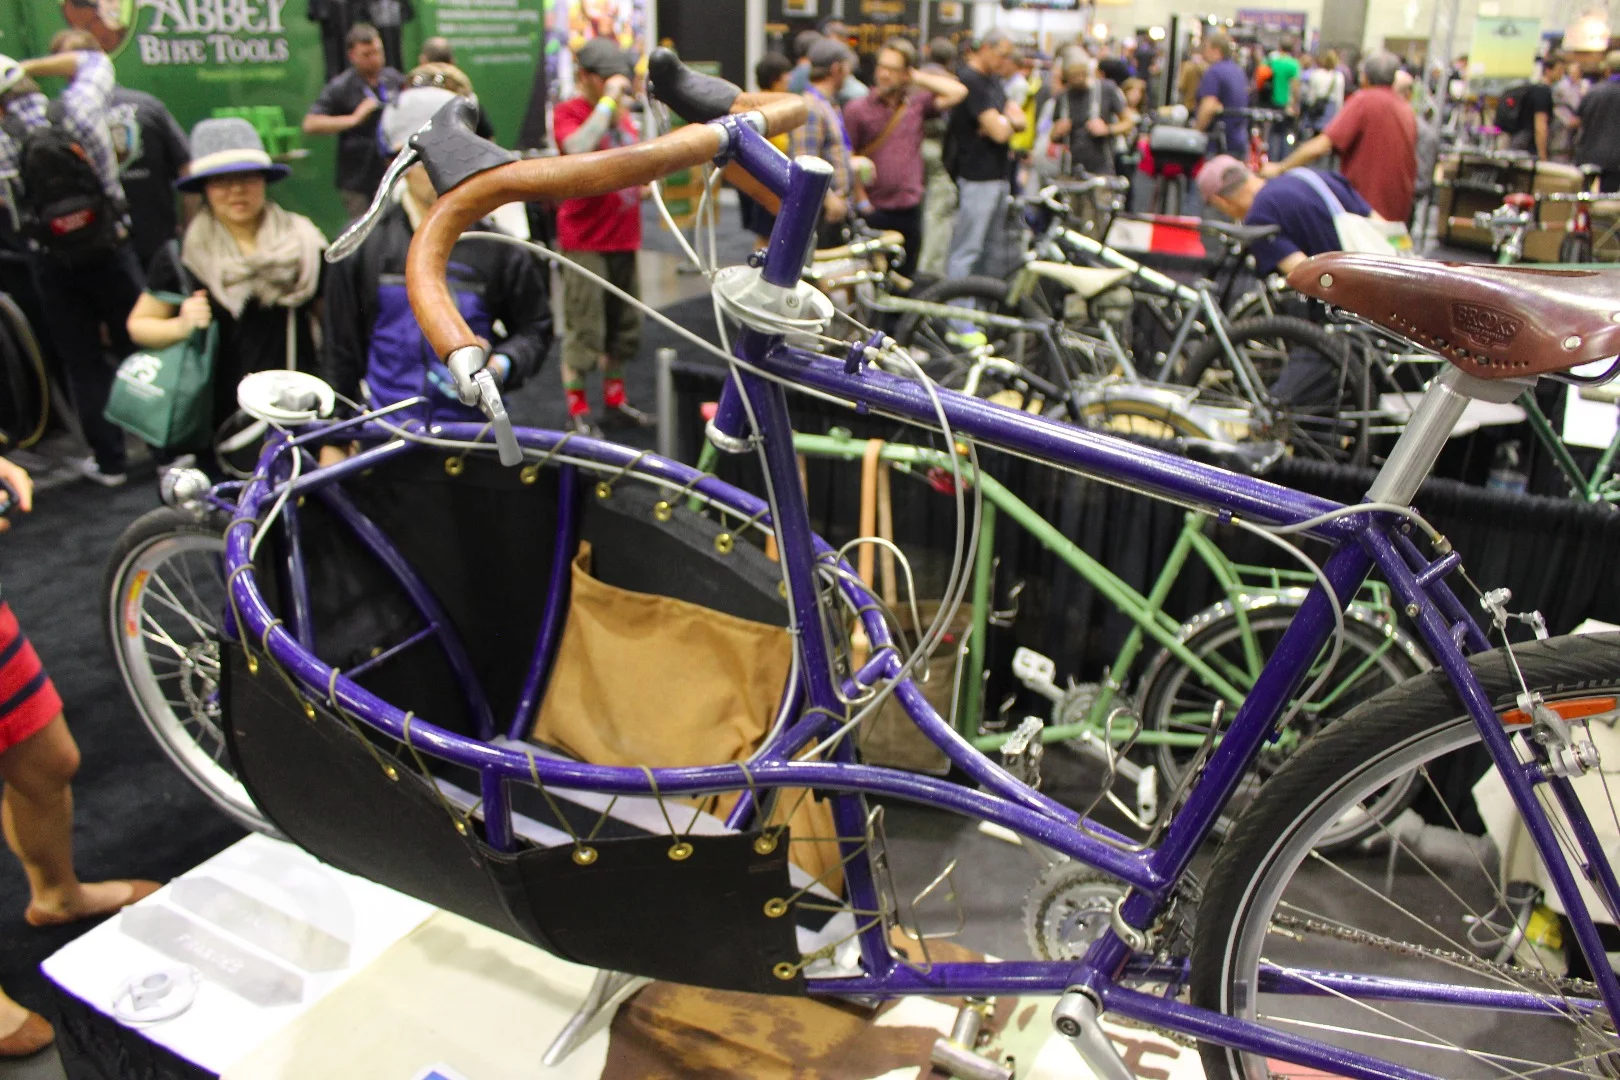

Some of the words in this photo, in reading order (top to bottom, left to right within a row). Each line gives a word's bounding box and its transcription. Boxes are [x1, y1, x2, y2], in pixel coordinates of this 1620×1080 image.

[138, 0, 285, 33] ABBEY
[207, 34, 289, 64] TOOLS
[1456, 303, 1517, 336] BROOKS
